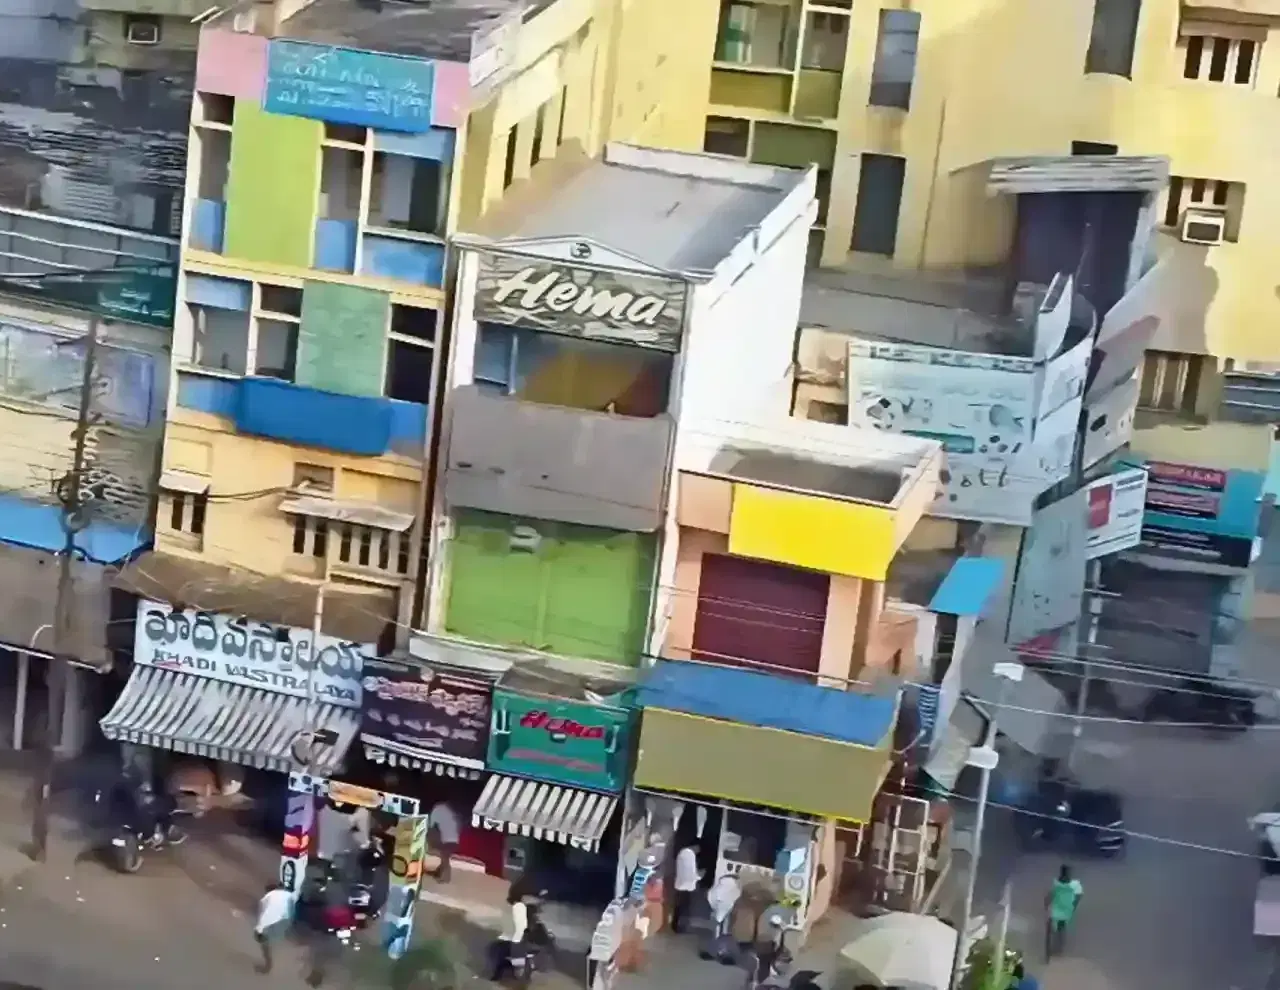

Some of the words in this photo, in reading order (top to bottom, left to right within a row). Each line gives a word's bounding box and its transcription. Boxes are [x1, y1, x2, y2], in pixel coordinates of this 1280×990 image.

[492, 266, 667, 326] Hema
[151, 648, 217, 672] KHADI
[224, 663, 356, 701] VASTRALAYA
